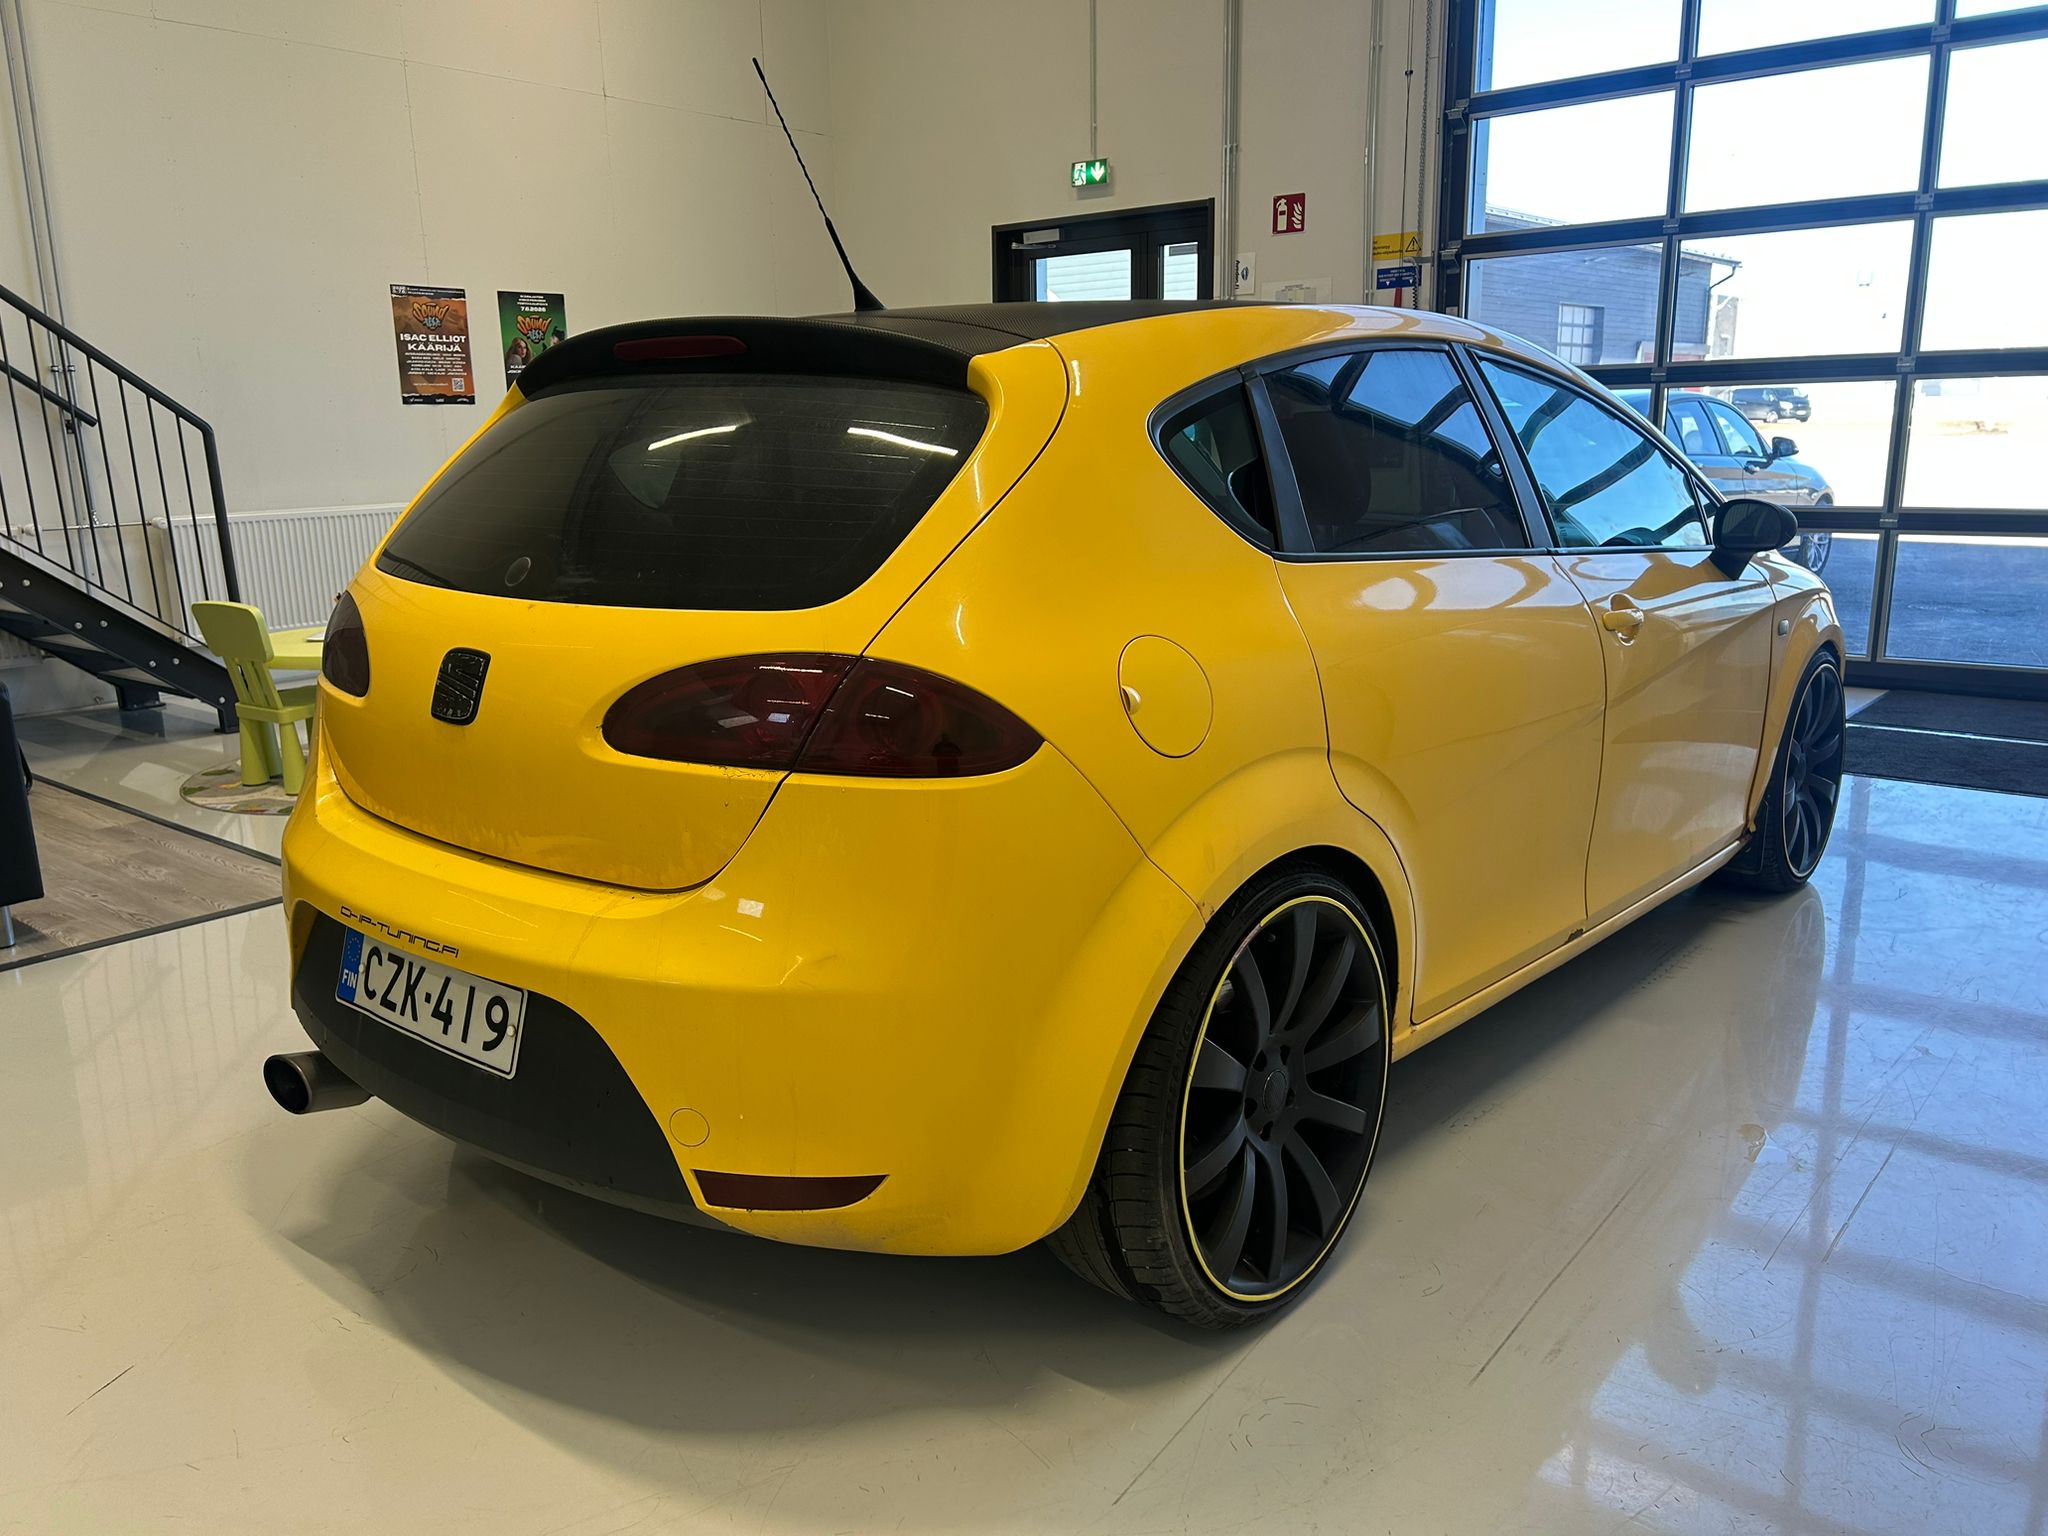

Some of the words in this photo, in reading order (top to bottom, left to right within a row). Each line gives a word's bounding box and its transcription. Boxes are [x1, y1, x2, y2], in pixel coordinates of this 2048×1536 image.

[400, 333, 427, 342] ISAC
[428, 334, 466, 343] ELLIOT
[407, 342, 462, 352] KÄÄRIJÄ
[341, 968, 358, 989] FIN
[364, 946, 510, 1052] CZK-419
